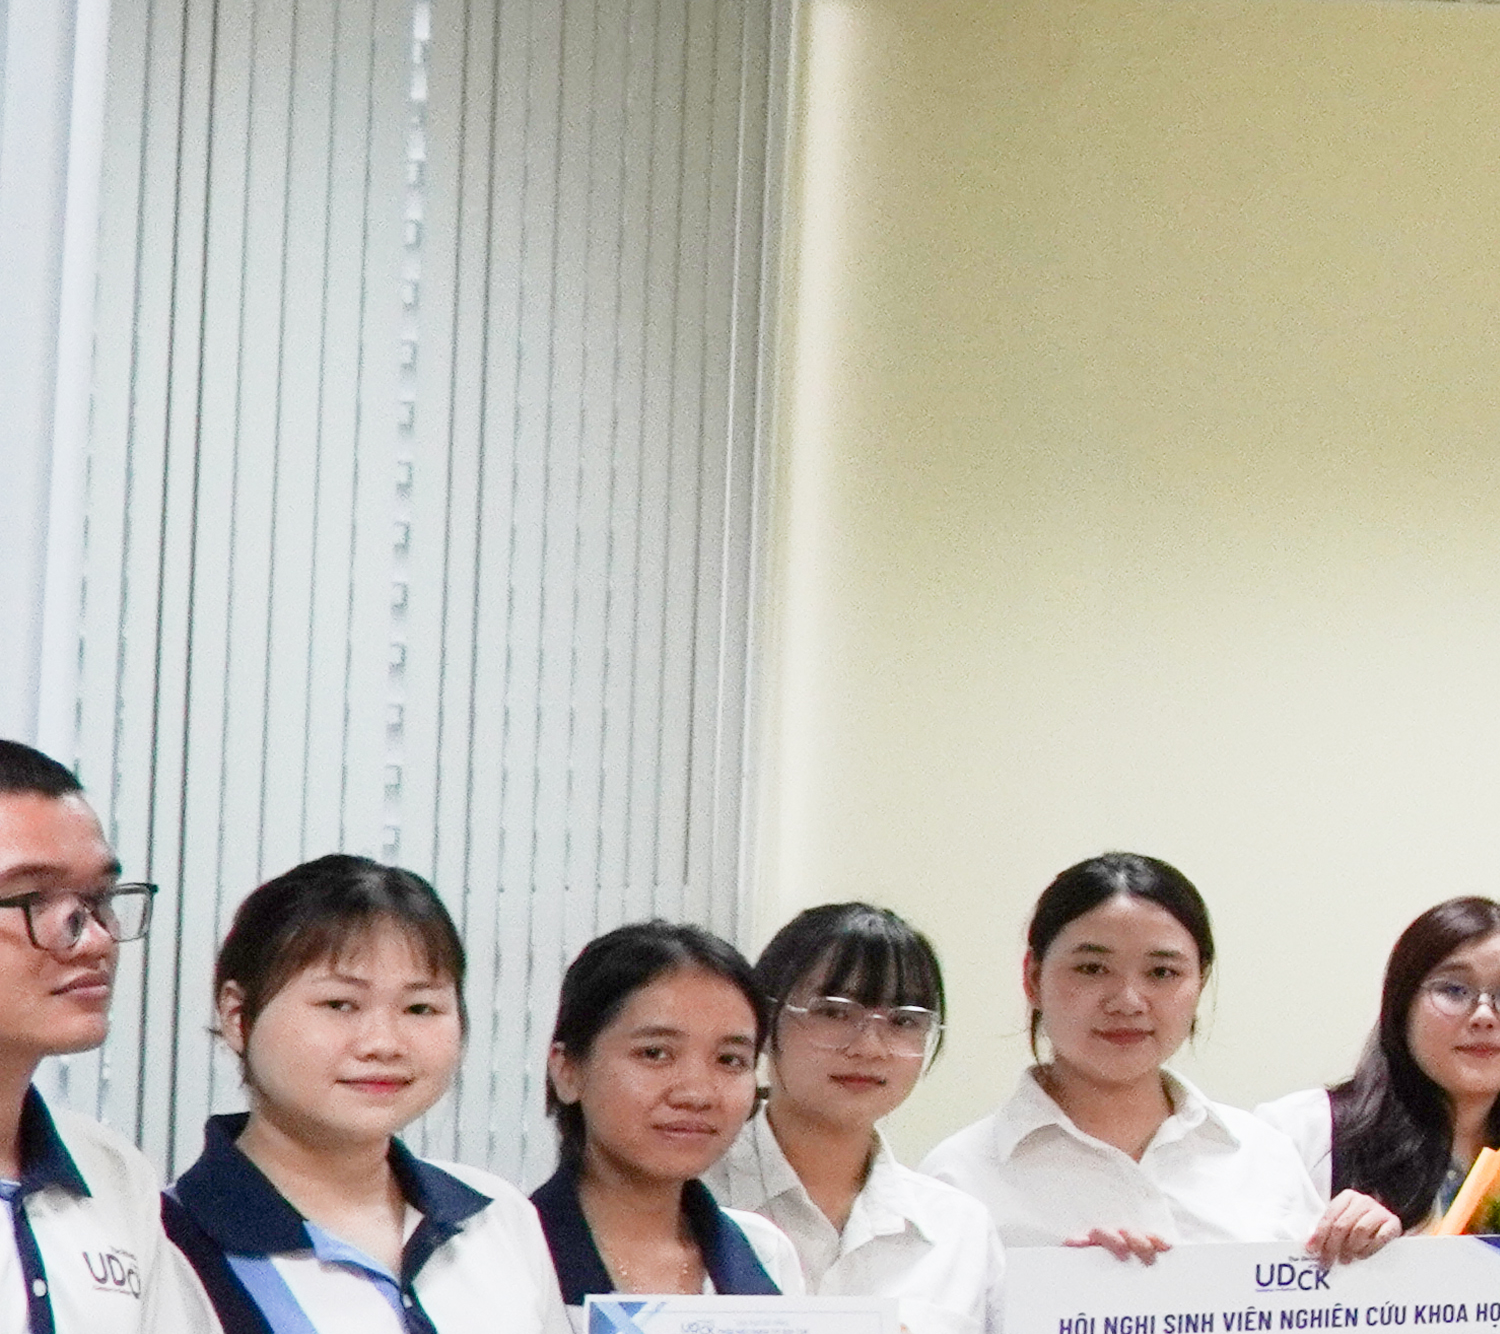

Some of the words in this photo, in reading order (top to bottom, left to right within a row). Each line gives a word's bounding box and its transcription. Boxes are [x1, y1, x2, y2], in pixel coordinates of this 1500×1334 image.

[1256, 1263, 1333, 1291] UDCK
[1163, 1313, 1214, 1334] SINH
[1223, 1306, 1272, 1332] VIÊN
[1280, 1304, 1358, 1330] NGHIÊN
[1366, 1302, 1406, 1326] CỨU
[1414, 1304, 1468, 1324] KHOA
